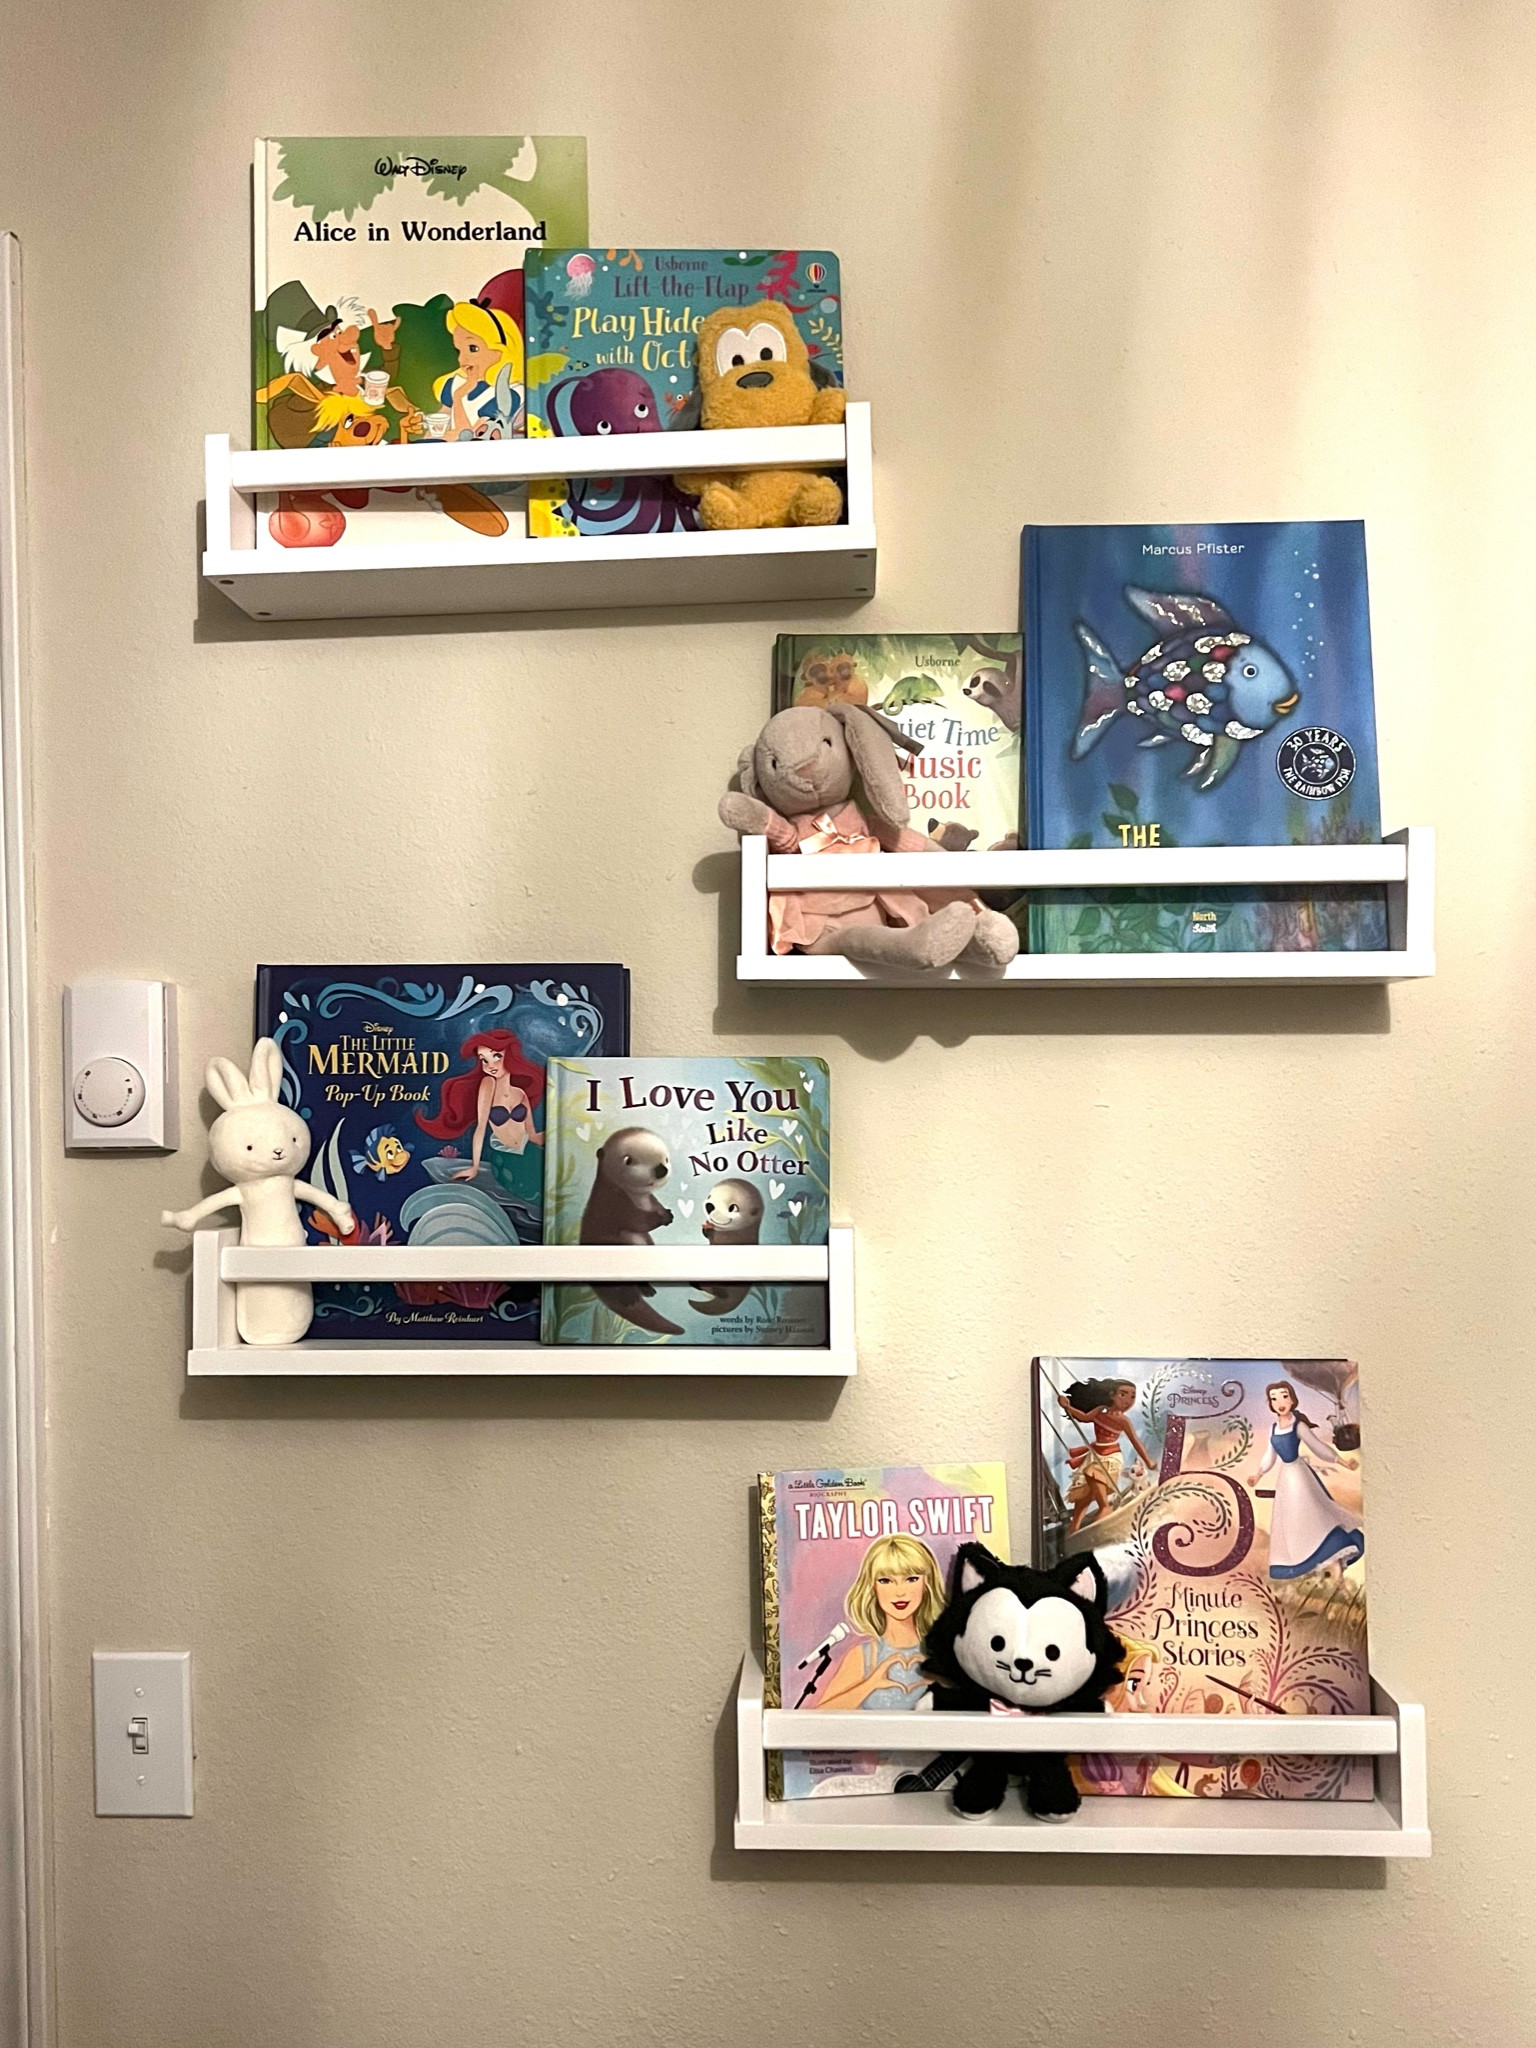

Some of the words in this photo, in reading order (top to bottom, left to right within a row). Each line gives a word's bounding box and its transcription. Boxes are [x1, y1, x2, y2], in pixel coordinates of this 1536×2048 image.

[374, 155, 409, 177] Walt
[405, 156, 467, 181] Disney
[294, 221, 357, 242] Alice
[368, 221, 390, 242] in
[401, 220, 547, 241] Wonderland
[654, 255, 709, 271] Usborne
[571, 306, 636, 342] Play
[640, 306, 705, 337] Hide
[595, 345, 635, 365] with
[1142, 543, 1192, 555] Marcus
[1197, 543, 1245, 555] Pfister
[914, 655, 961, 668] Usborne
[942, 717, 1001, 747] Time
[1286, 736, 1304, 752] 30
[1305, 729, 1347, 753] YEARS
[895, 749, 982, 779] Music
[1283, 766, 1298, 784] THE
[1294, 781, 1337, 796] RAINBOW
[1335, 768, 1352, 788] FISH
[903, 781, 971, 809] Book
[1118, 823, 1161, 847] THE
[361, 1021, 395, 1036] Disney
[307, 1044, 450, 1079] MERMAID
[325, 1084, 386, 1108] Pop-Up
[389, 1085, 431, 1102] Book
[586, 1079, 602, 1112] I
[619, 1076, 715, 1111] Love
[725, 1080, 801, 1113] You
[706, 1118, 768, 1145] Like
[689, 1151, 729, 1176] No
[737, 1150, 810, 1176] Otter
[385, 1311, 402, 1325] By
[402, 1311, 444, 1324] Matthew
[711, 1325, 743, 1335] pictures
[744, 1325, 754, 1335] by
[720, 1315, 743, 1324] words
[744, 1315, 754, 1325] by
[815, 1478, 844, 1488] Golden
[794, 1499, 900, 1541] TAYLOR
[908, 1496, 995, 1536] SWIFT
[1164, 1581, 1243, 1612] Minute
[1149, 1608, 1259, 1643] Princess
[1162, 1640, 1247, 1667] Stories
